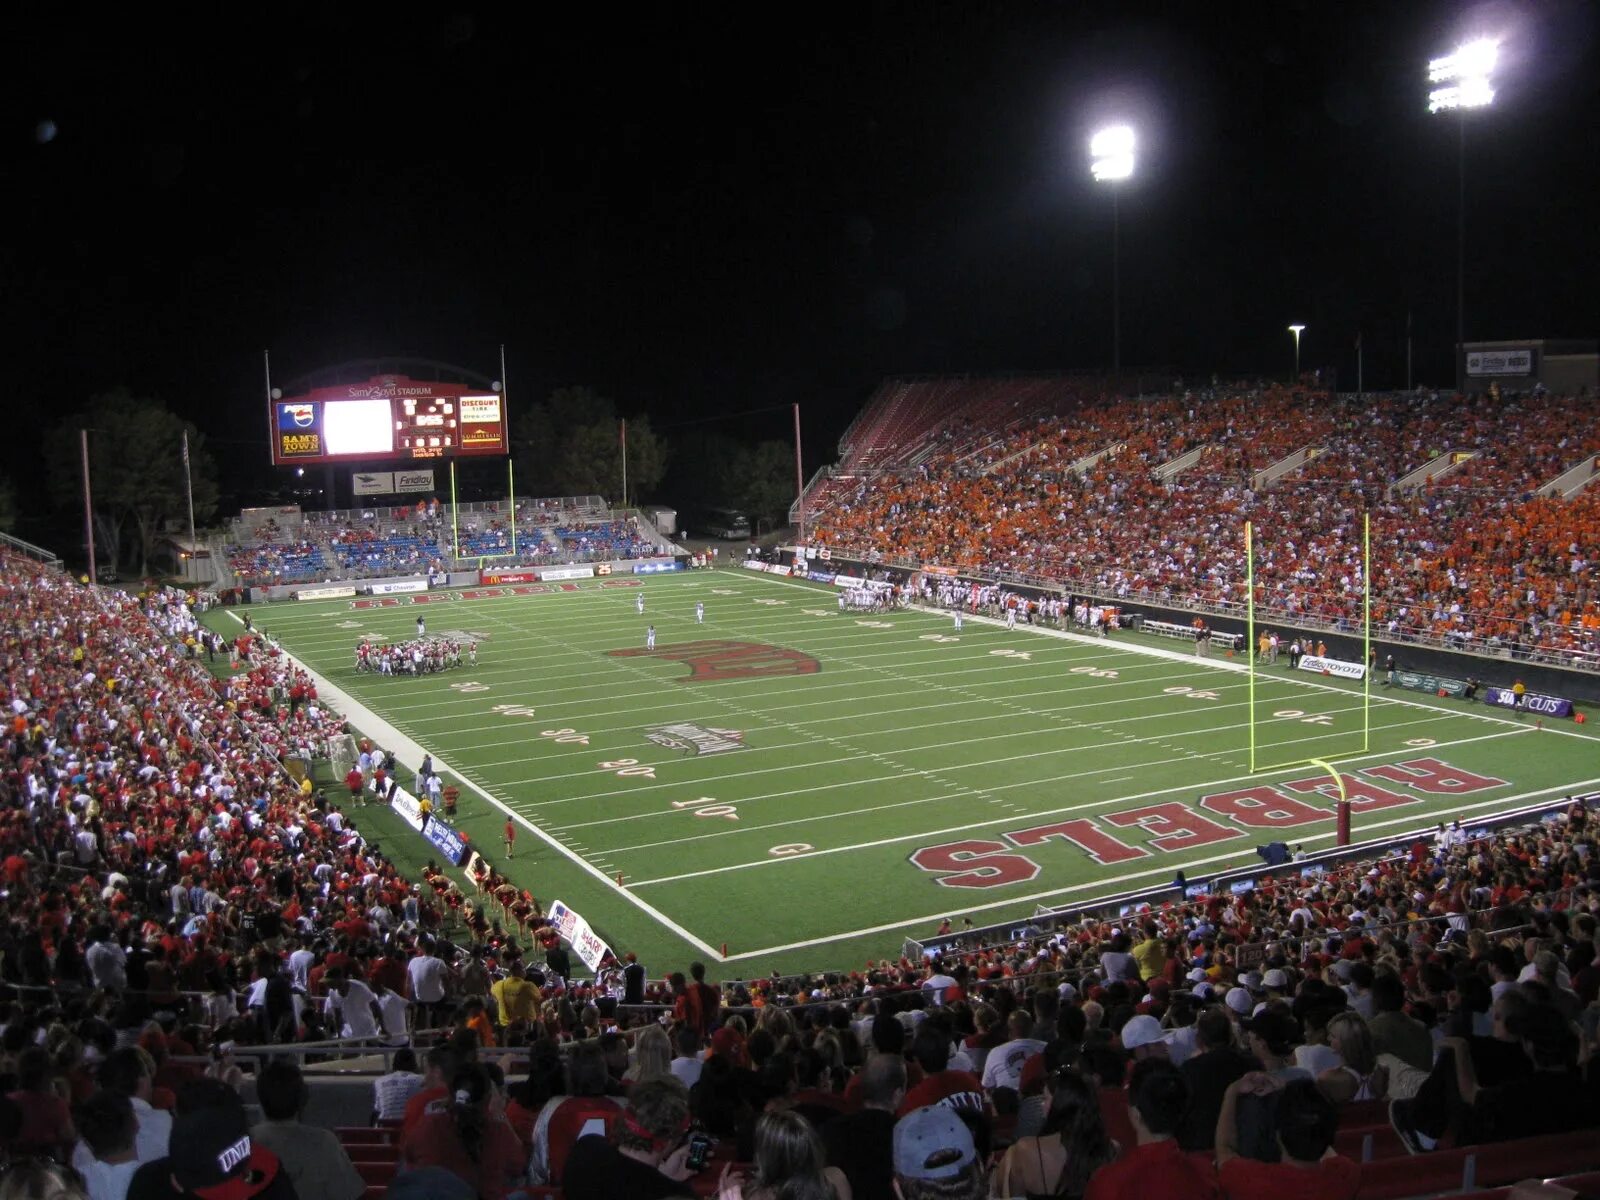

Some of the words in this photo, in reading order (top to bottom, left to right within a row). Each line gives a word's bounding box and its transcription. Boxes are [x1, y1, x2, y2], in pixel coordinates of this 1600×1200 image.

[396, 387, 432, 396] STADIUM
[285, 442, 319, 451] TOWN
[399, 475, 432, 486] Findlay
[597, 563, 612, 576] 25
[1326, 663, 1362, 675] TOYOTA
[670, 796, 739, 819] 10
[909, 757, 1514, 890] REBELS
[767, 842, 815, 857] G
[1241, 949, 1263, 962] 120
